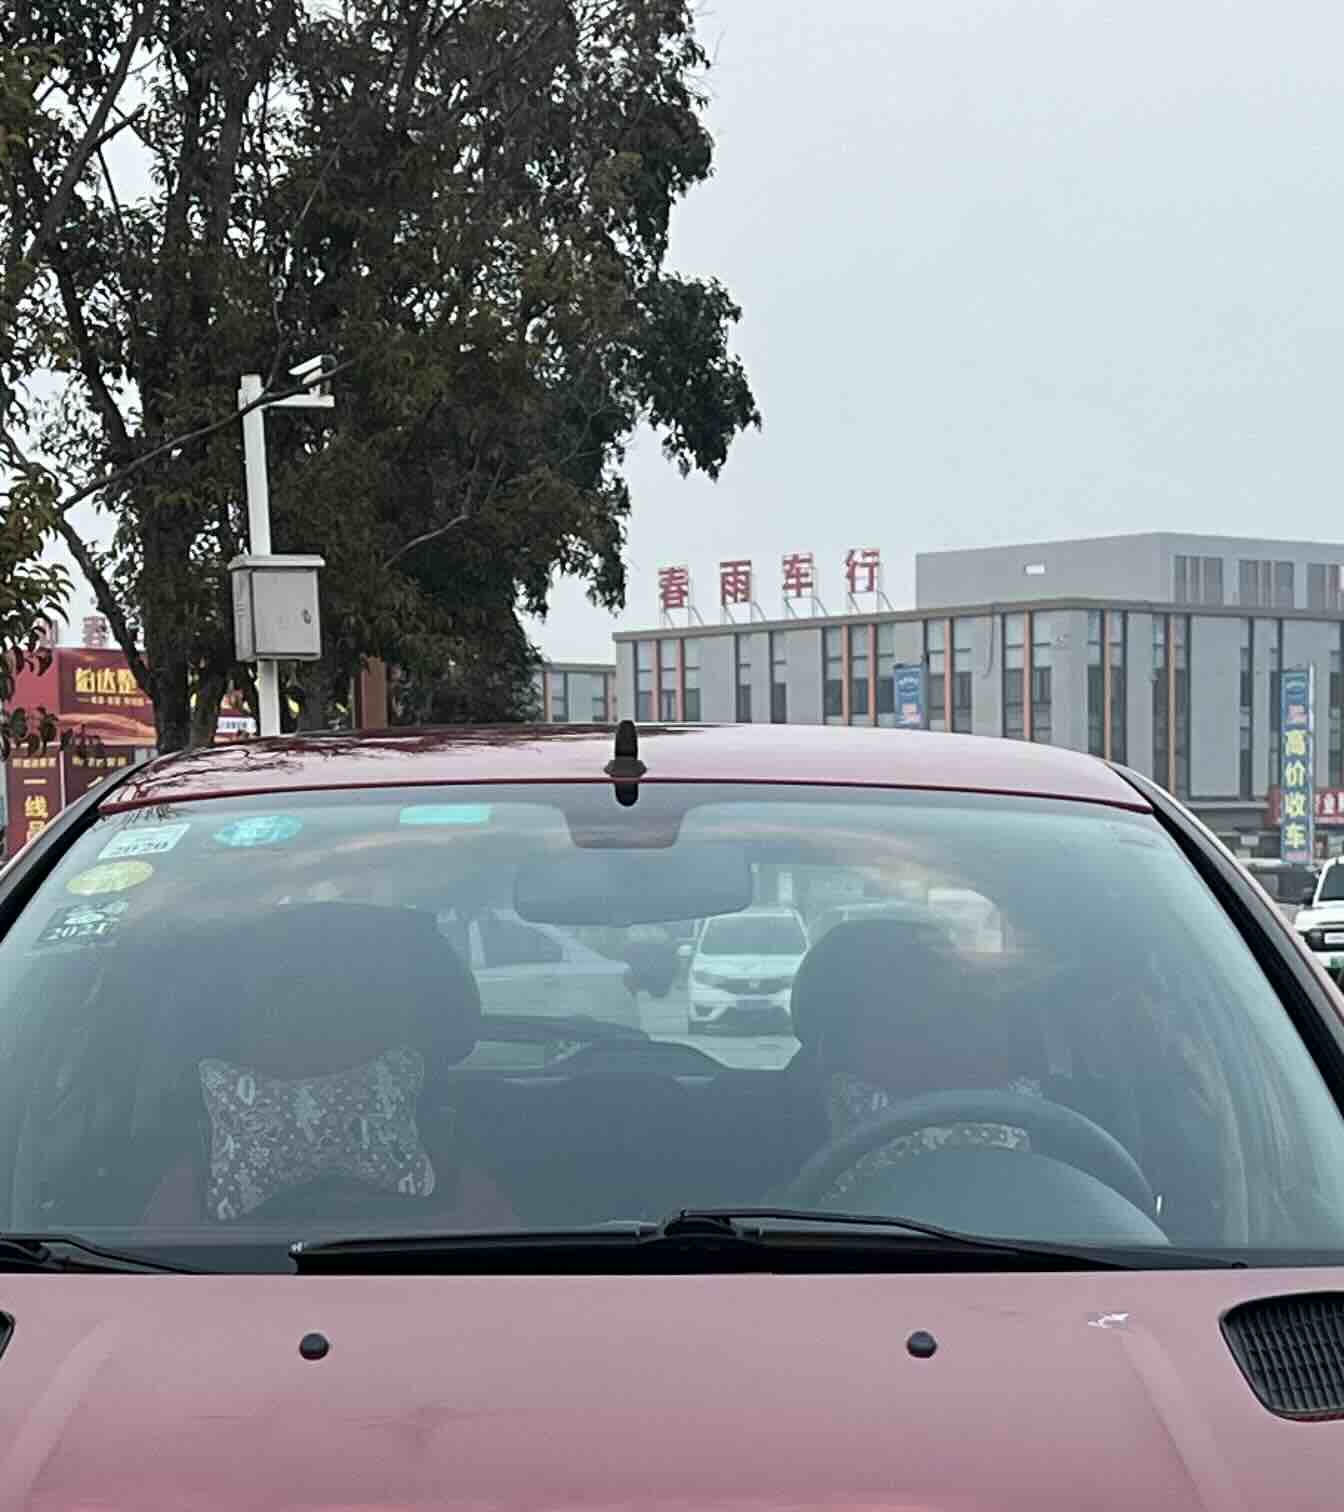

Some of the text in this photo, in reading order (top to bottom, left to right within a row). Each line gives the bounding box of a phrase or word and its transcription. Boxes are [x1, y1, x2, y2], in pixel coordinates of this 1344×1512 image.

[657, 547, 881, 610] 春雨车行
[1284, 729, 1306, 849] 高价收车
